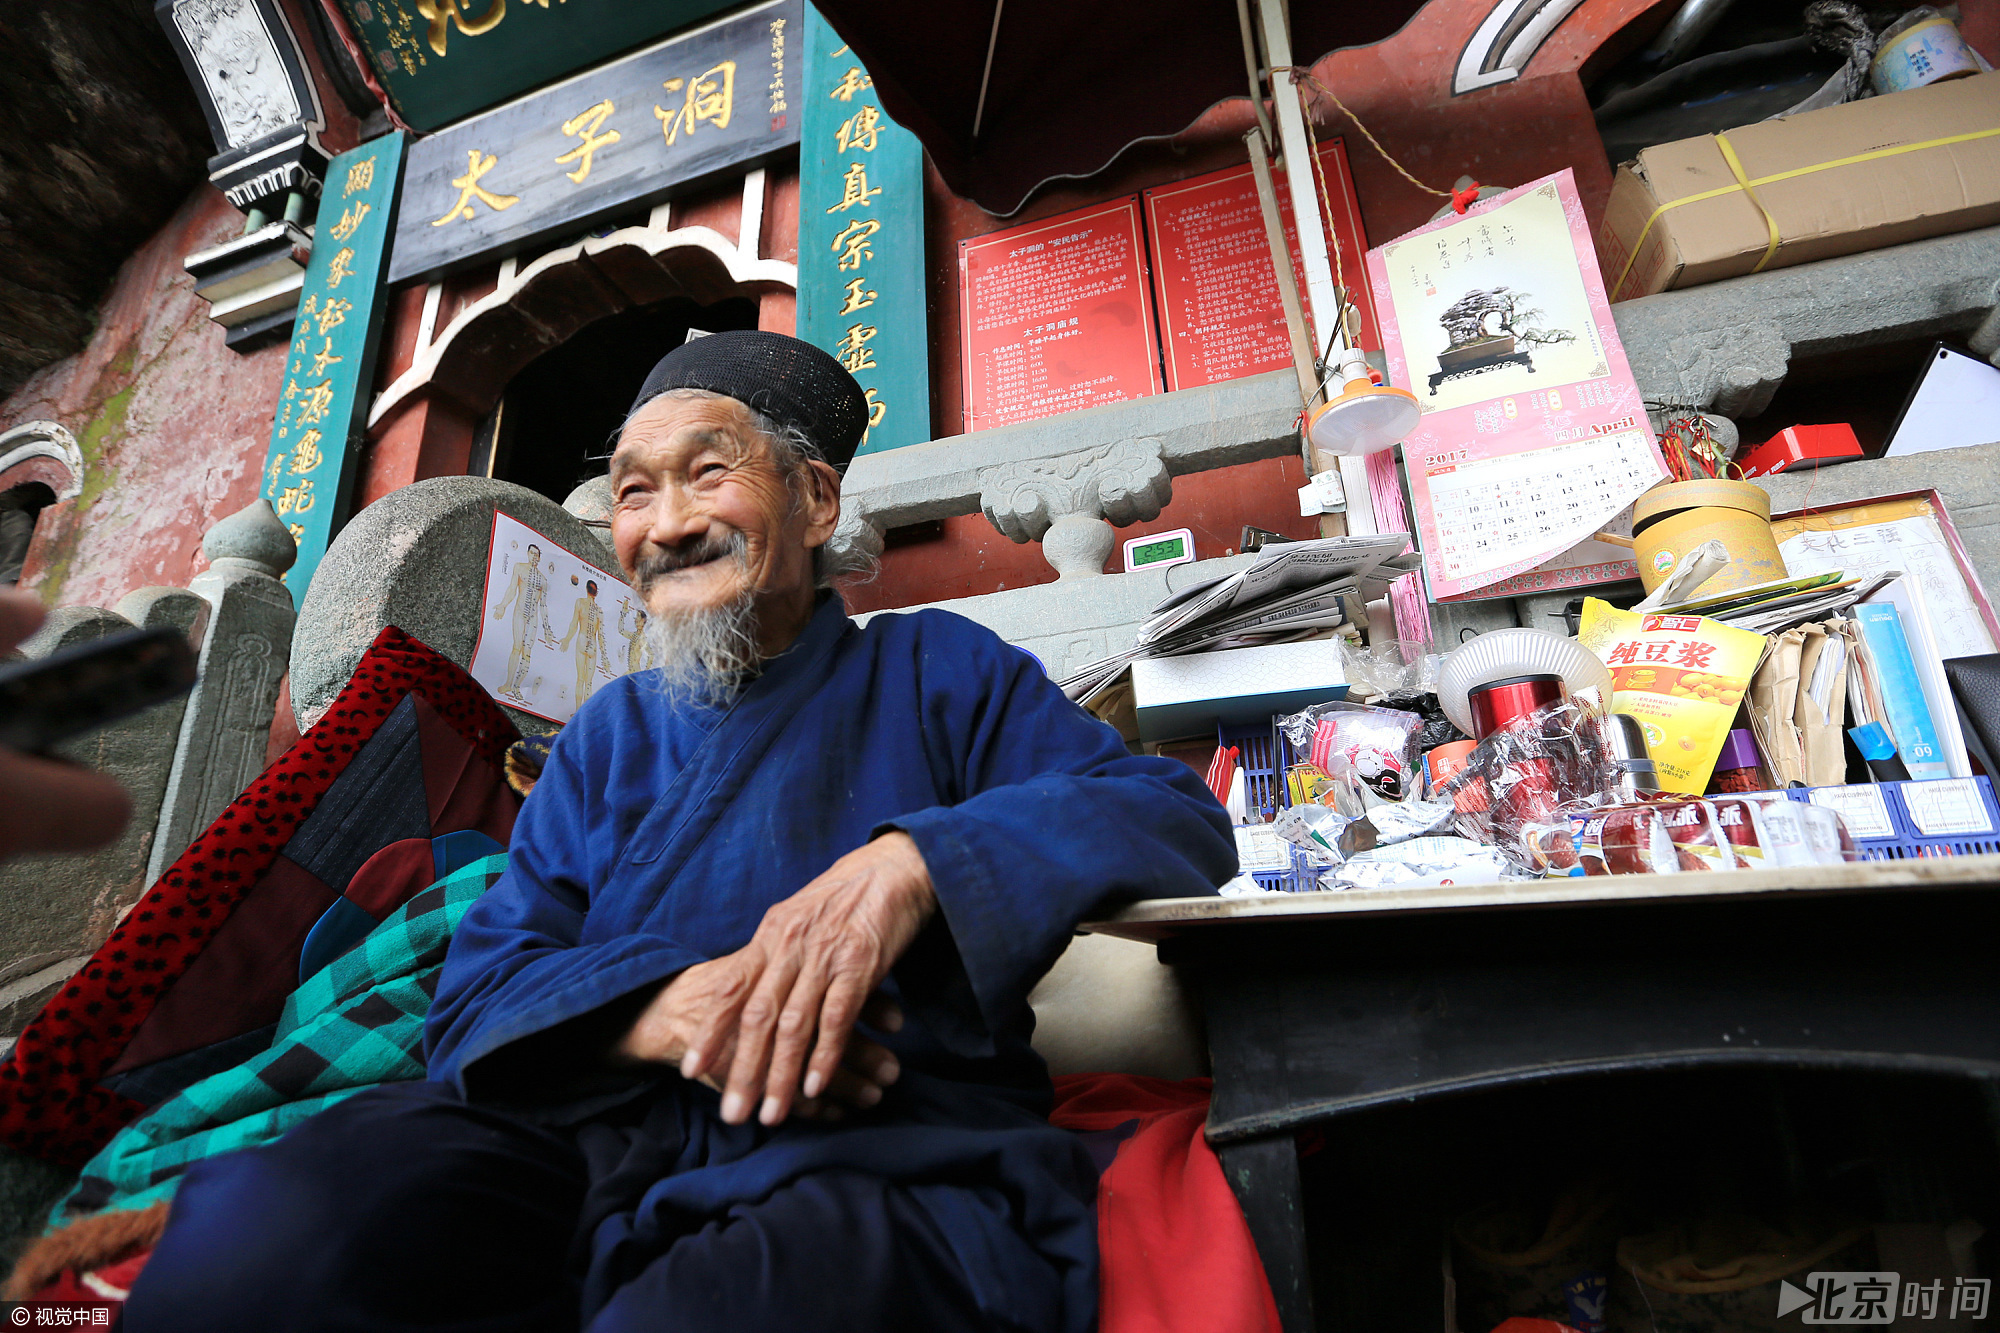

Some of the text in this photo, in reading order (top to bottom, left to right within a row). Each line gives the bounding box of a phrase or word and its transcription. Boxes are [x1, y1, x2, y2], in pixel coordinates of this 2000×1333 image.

[432, 60, 737, 227] 太子洞
[1022, 315, 1079, 337] 太子洞庙规
[1589, 416, 1636, 435] April
[1425, 449, 1468, 467] 2017
[1434, 494, 1440, 502] 2
[1499, 500, 1509, 508] 11
[1562, 486, 1573, 494] 13
[1595, 479, 1605, 487] 14
[1473, 523, 1483, 531] 17
[1535, 510, 1546, 518] 19
[1566, 502, 1578, 510] 20
[1600, 493, 1610, 501] 21
[1634, 482, 1645, 490] 22
[1145, 541, 1174, 557] 2:53
[1445, 546, 1456, 554] 23
[1476, 540, 1487, 548] 24
[1507, 533, 1518, 541] 25
[1449, 563, 1460, 571] 30
[1606, 640, 1717, 668] 纯豆浆
